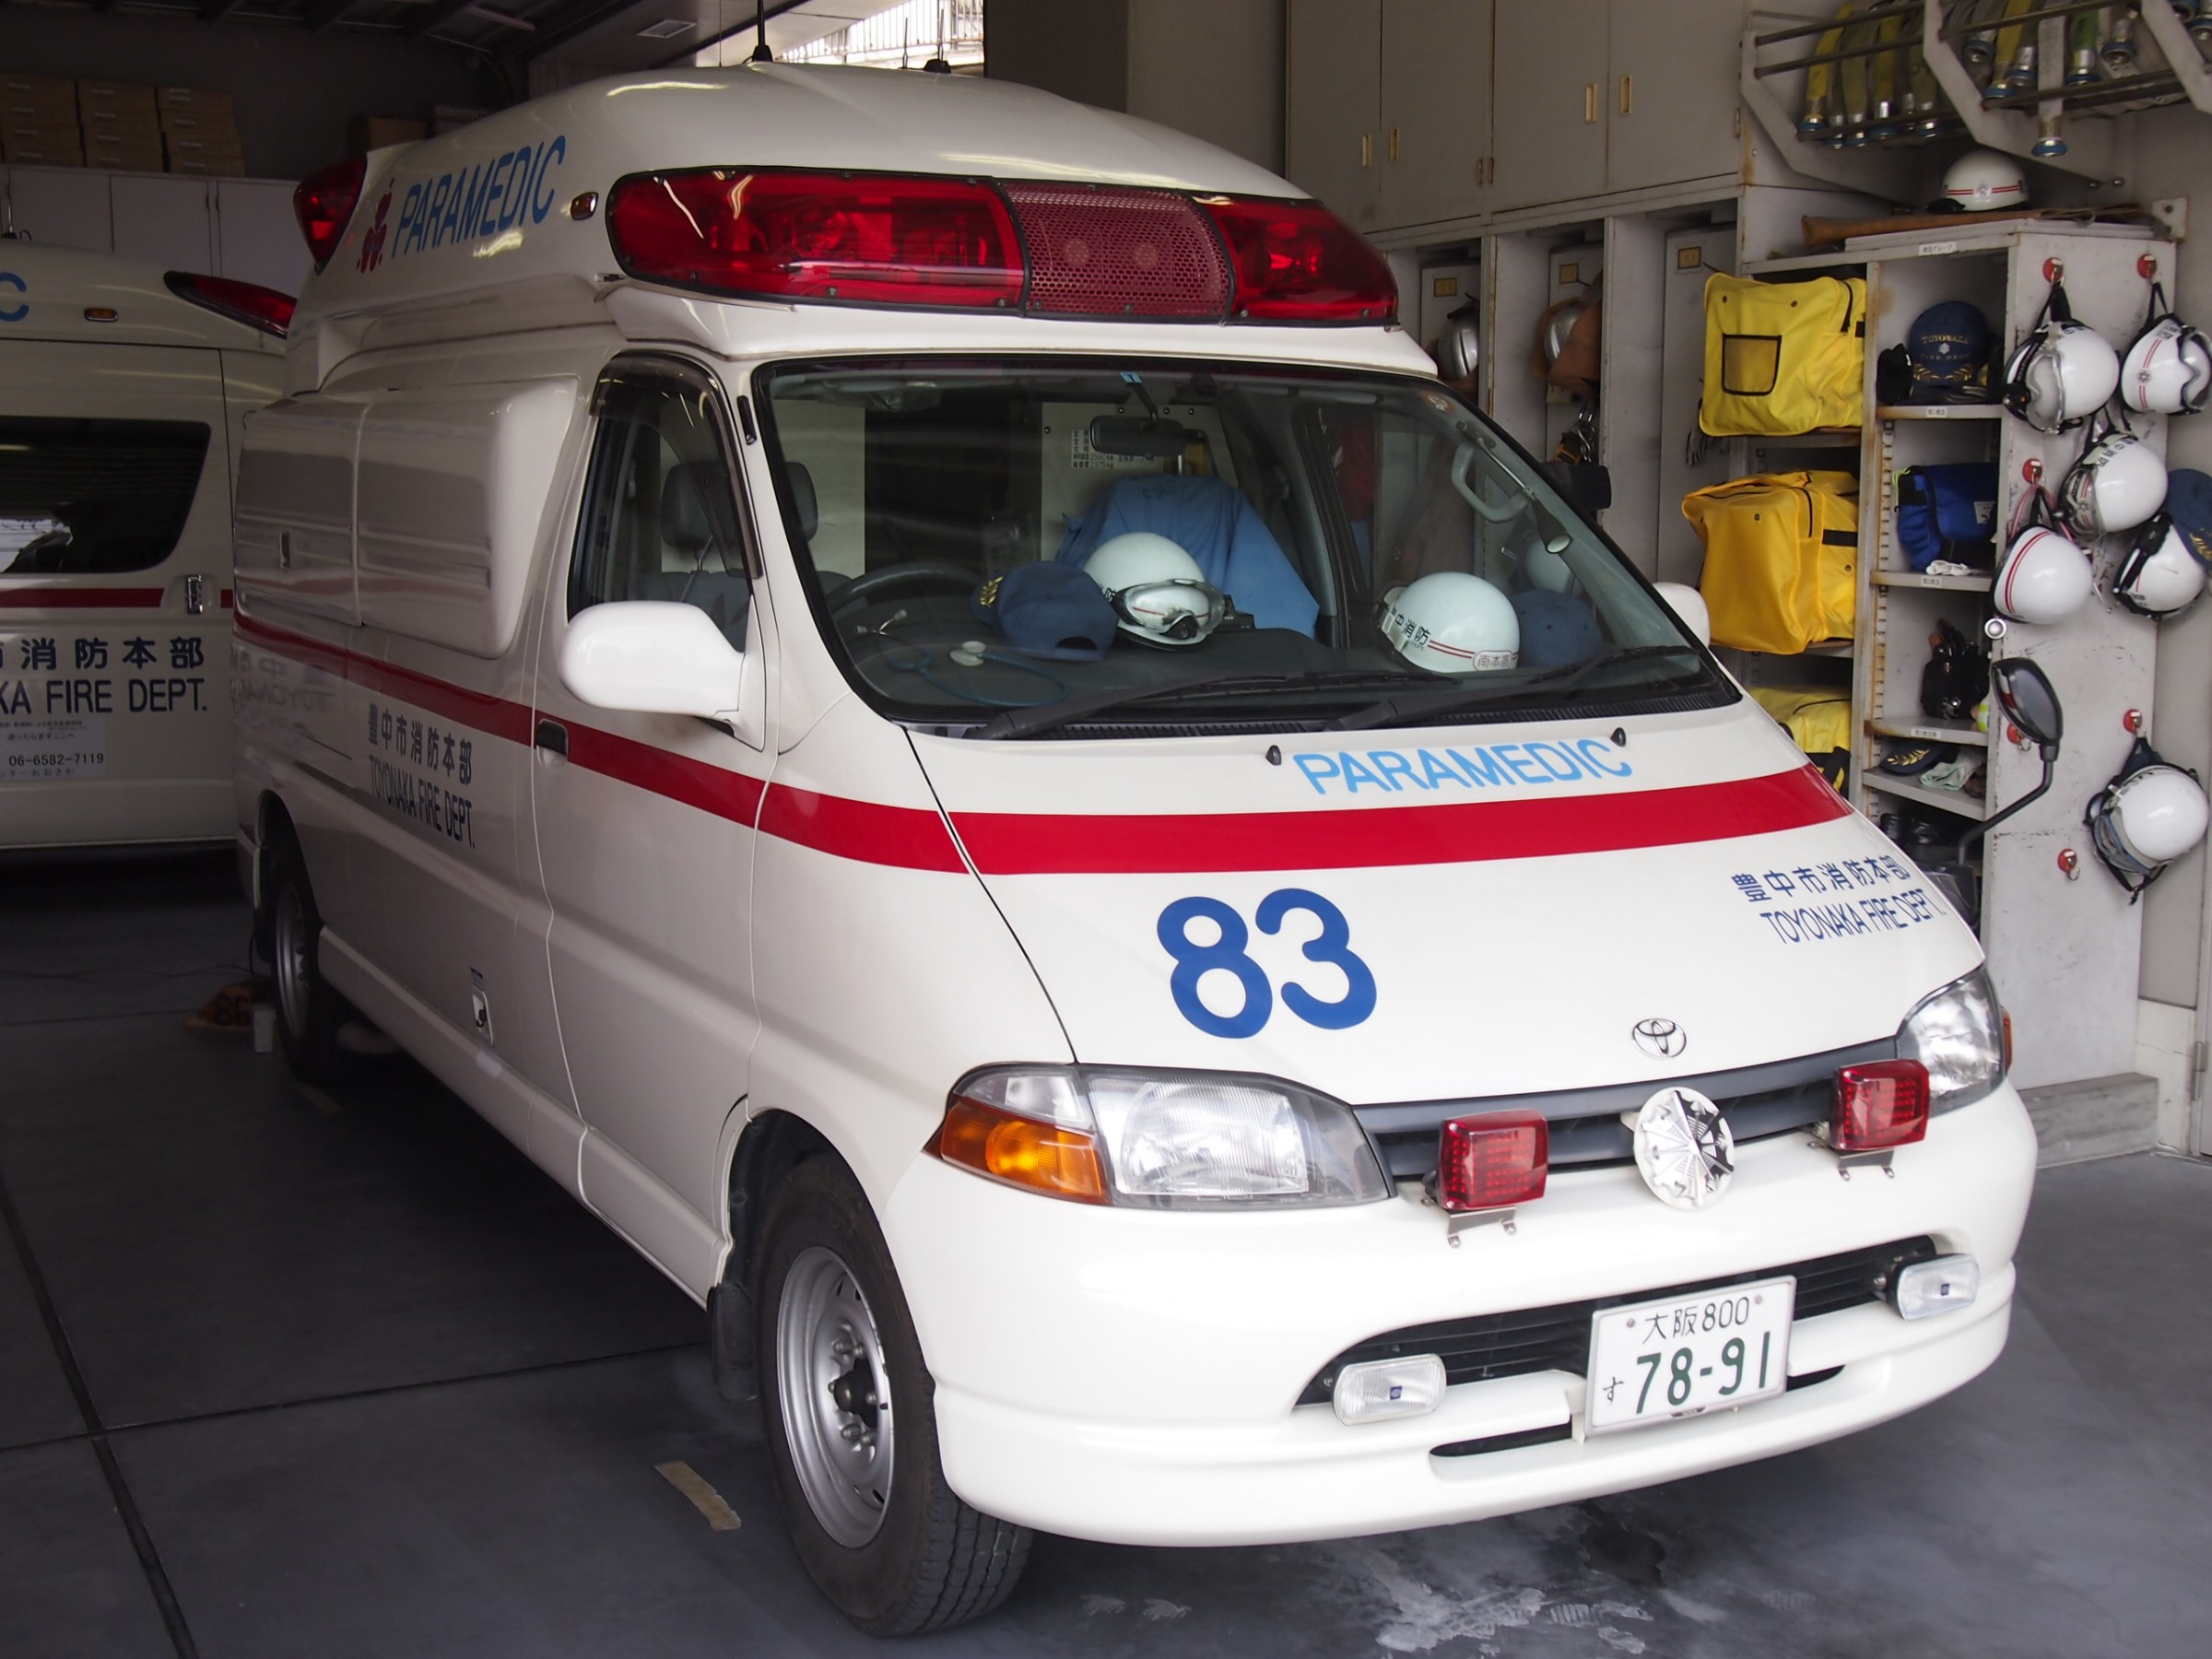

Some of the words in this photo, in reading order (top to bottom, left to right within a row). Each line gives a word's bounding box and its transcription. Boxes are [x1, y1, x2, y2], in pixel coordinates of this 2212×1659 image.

[392, 135, 567, 259] PARAMEDIC
[0, 637, 205, 670] 消防本部
[46, 678, 113, 713] FIRE
[128, 677, 207, 712] DEPT.
[8, 752, 104, 767] 06-6582-7119
[369, 702, 472, 785] 豊中市消防本部
[1292, 738, 1632, 794] PARAMEDIC
[369, 754, 418, 818] TOYONAKA
[418, 778, 442, 833] FIRE
[444, 790, 476, 849] DEPT.
[1731, 855, 1911, 902] 豊中市消防本部
[1759, 902, 1871, 944] TOYONAKA
[1858, 897, 1909, 931] FIRE
[1891, 888, 1947, 924] DEPT.
[1157, 888, 1377, 1039] 83
[1602, 1376, 1624, 1404] す
[1636, 1331, 1771, 1414] 78-91
